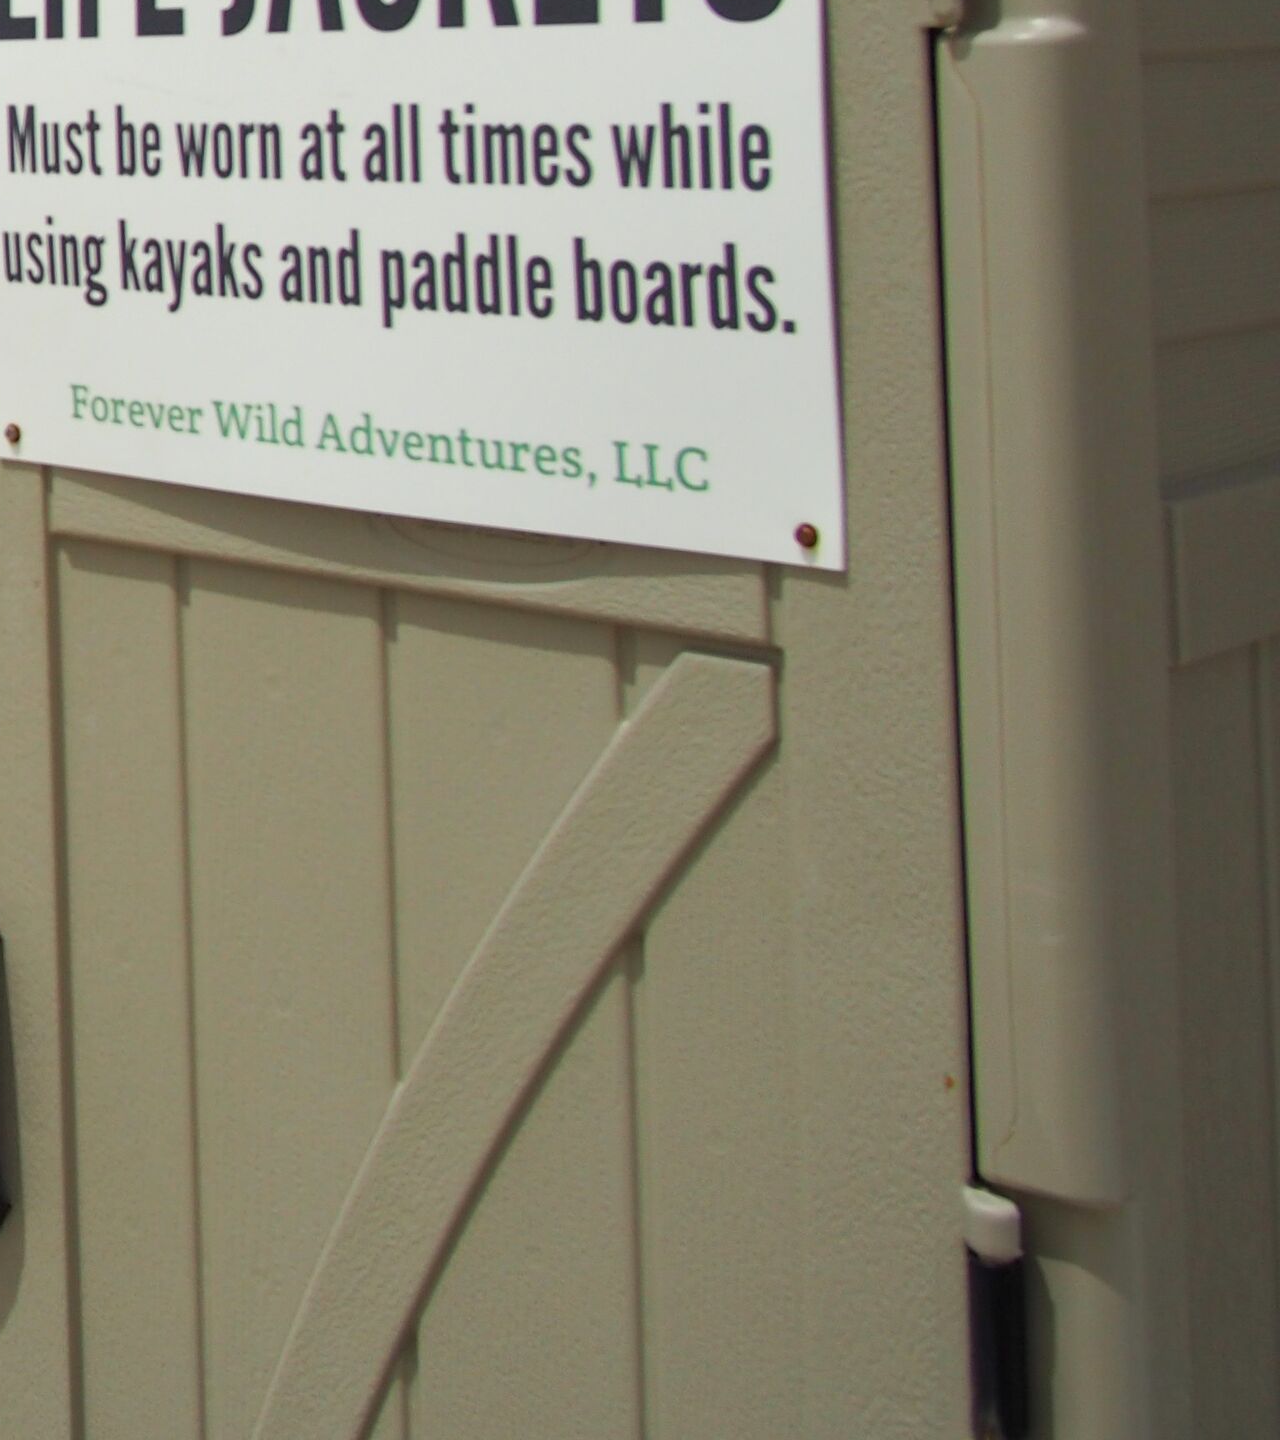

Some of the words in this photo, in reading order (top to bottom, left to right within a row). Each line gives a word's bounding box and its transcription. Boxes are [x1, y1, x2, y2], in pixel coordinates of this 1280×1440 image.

[8, 105, 102, 175] Must
[116, 105, 161, 177] be
[176, 123, 282, 179] worn
[301, 110, 346, 182] at
[364, 104, 421, 183] all
[439, 104, 593, 187] times
[611, 103, 771, 191] while
[3, 216, 107, 307] using
[119, 219, 264, 312] kayaks
[281, 229, 362, 306] and
[381, 233, 554, 328] paddle
[574, 237, 796, 334] boards.
[70, 384, 203, 434] Forever
[212, 400, 305, 447] Wild
[317, 413, 597, 487] Adventures,
[614, 441, 709, 492] LLC
